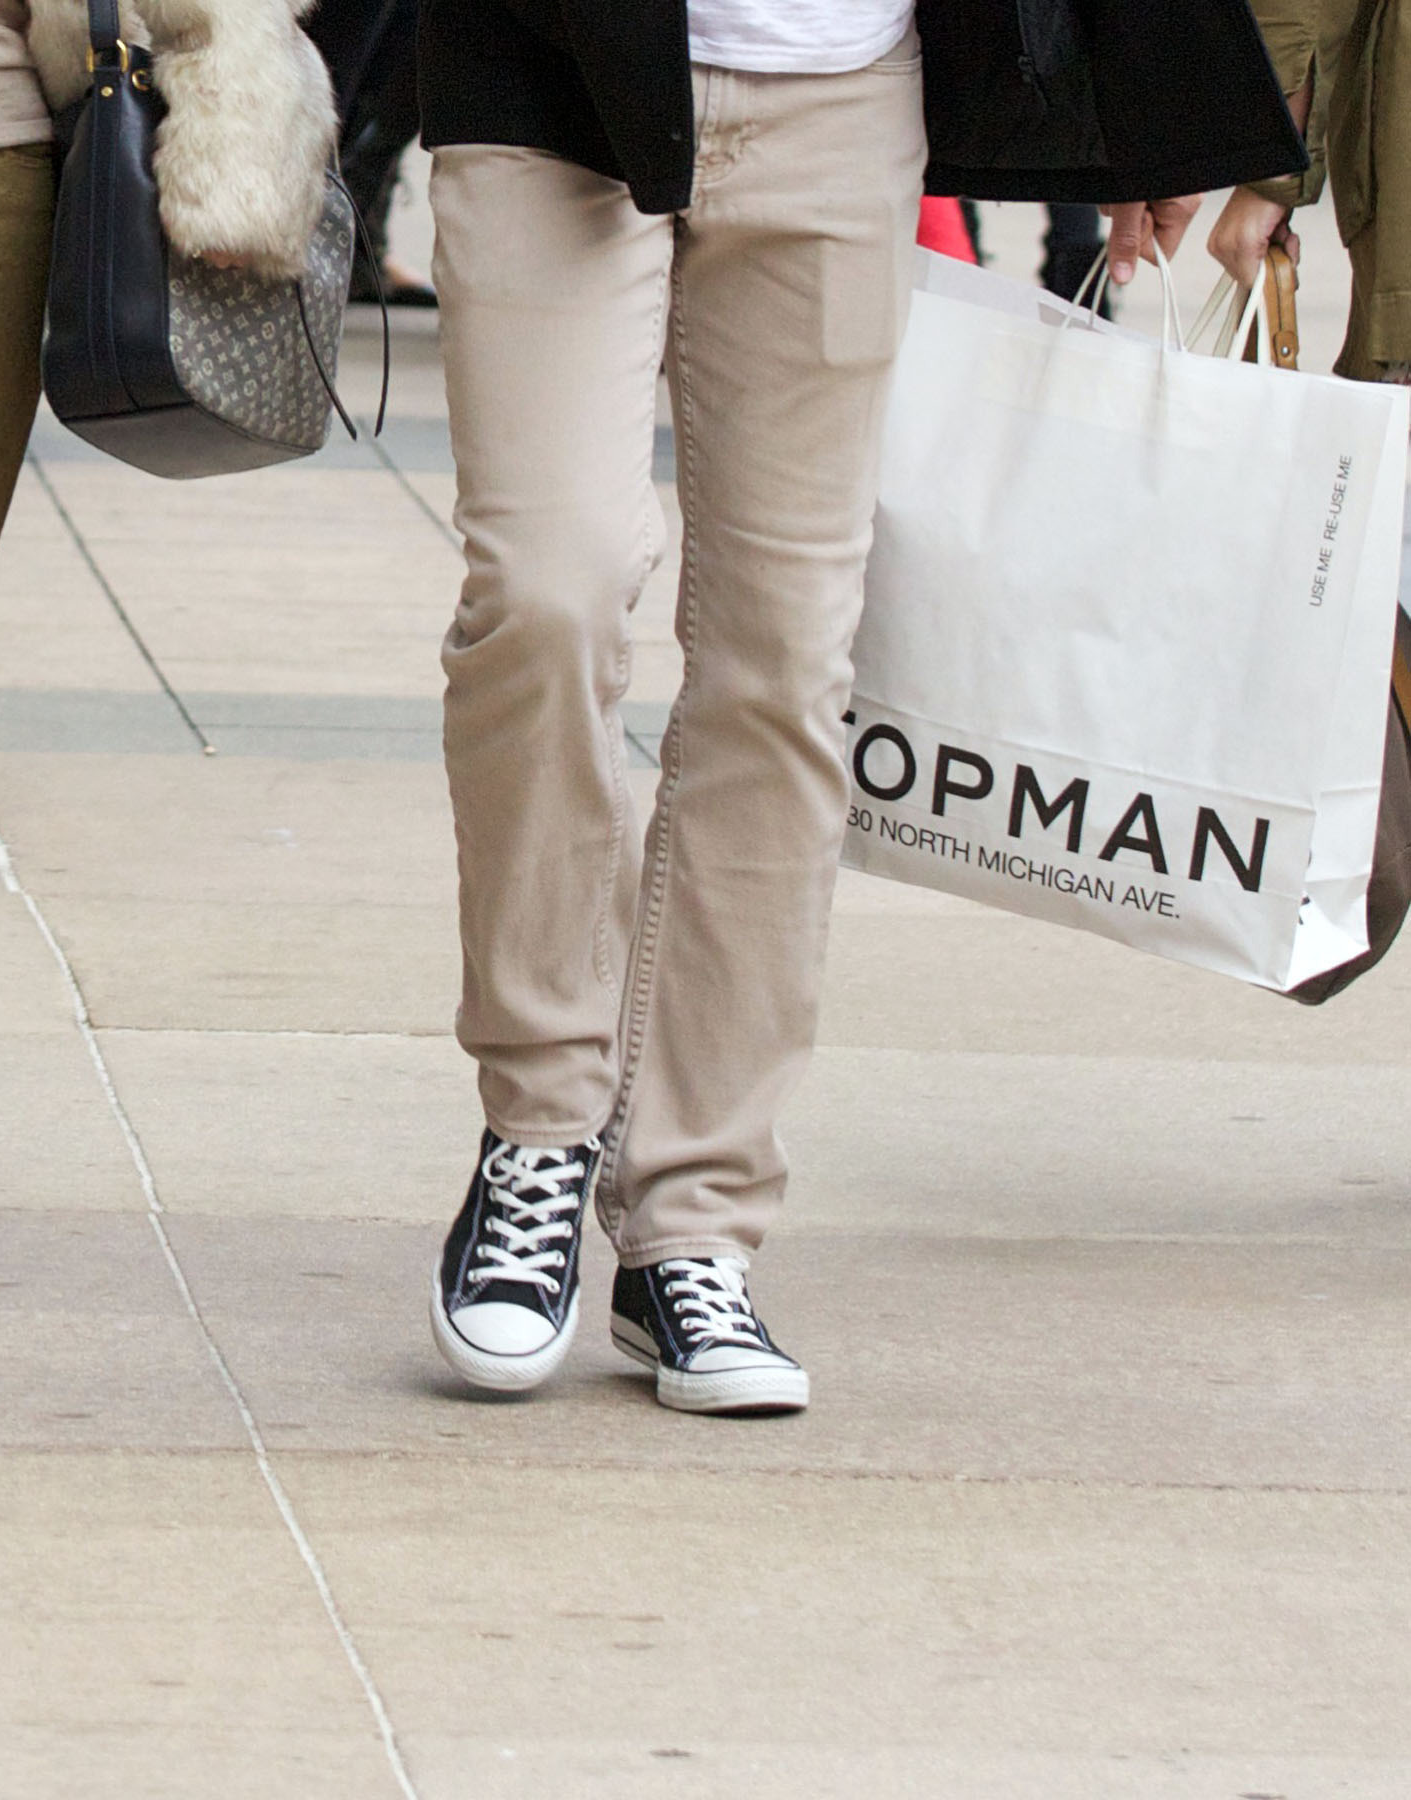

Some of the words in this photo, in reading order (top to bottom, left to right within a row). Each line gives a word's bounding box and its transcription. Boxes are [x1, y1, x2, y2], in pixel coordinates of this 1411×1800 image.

[1336, 454, 1353, 480] ME
[1323, 482, 1347, 541] RE-USE
[1316, 547, 1333, 572] ME
[1309, 575, 1327, 608] USE
[841, 709, 1270, 893] OPMAN
[879, 815, 970, 864] NORTH
[977, 845, 1115, 903] MICHIGAN
[1121, 885, 1181, 919] AVE.
